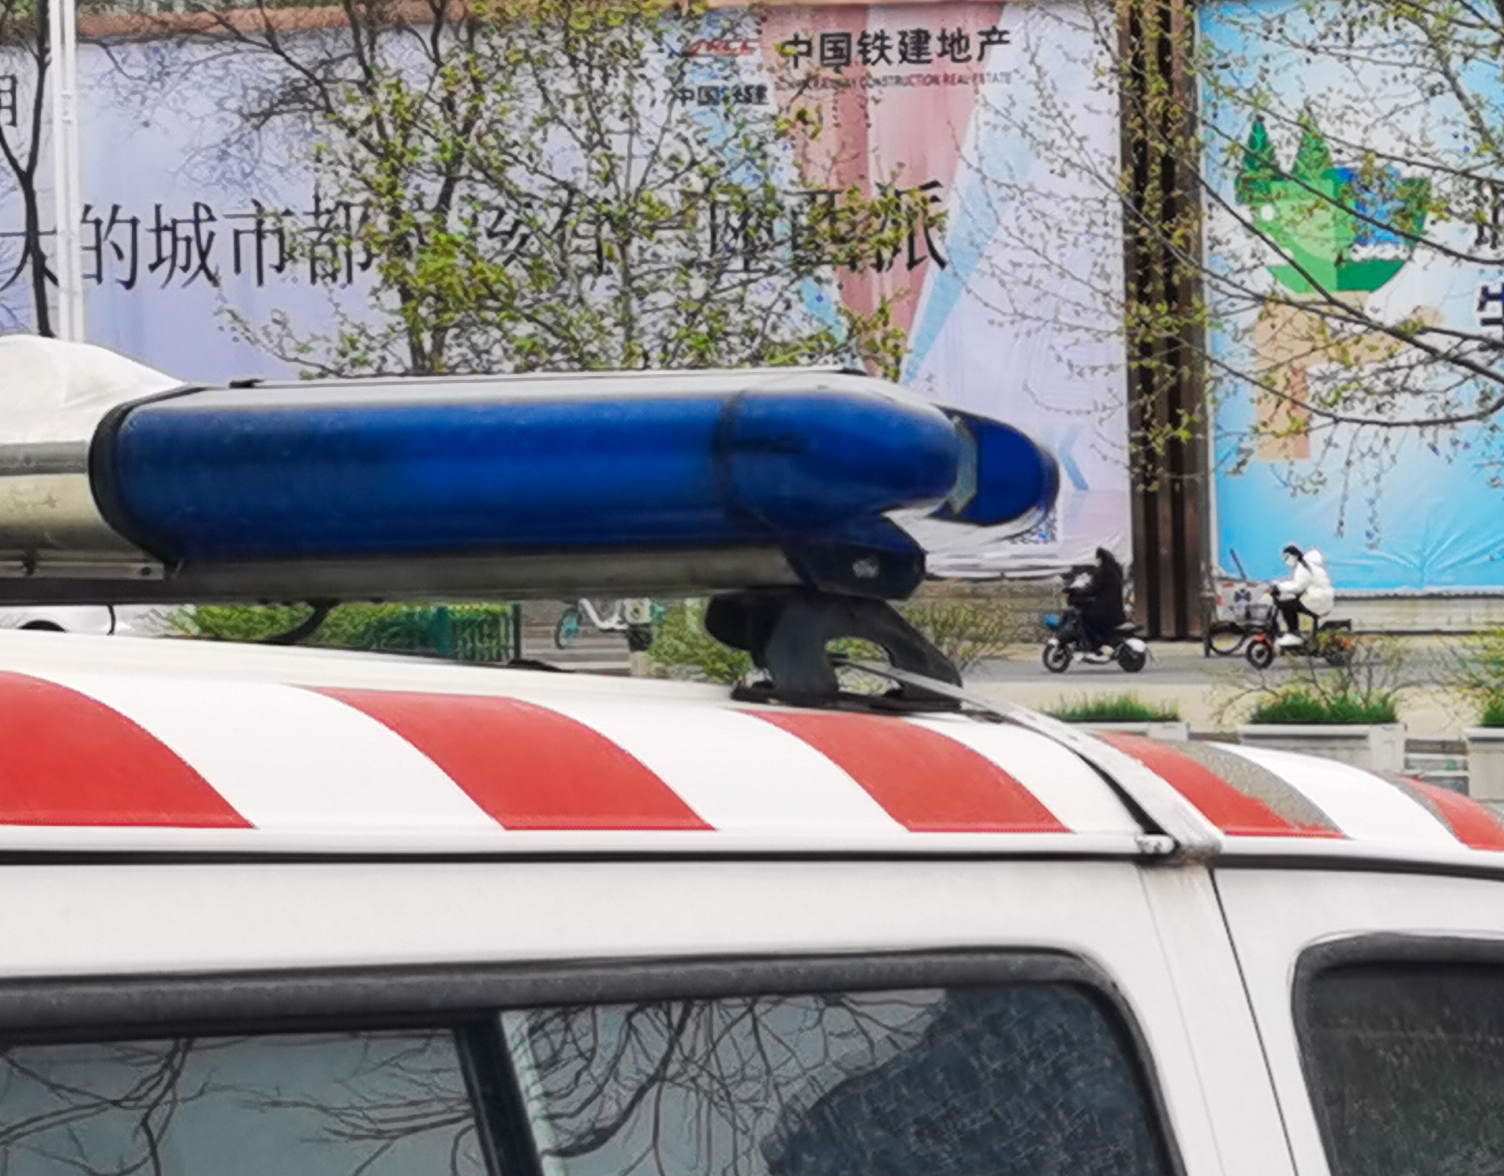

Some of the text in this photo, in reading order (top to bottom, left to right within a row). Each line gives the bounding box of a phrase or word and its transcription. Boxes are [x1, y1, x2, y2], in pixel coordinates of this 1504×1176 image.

[780, 25, 1011, 69] 中国铁建地产
